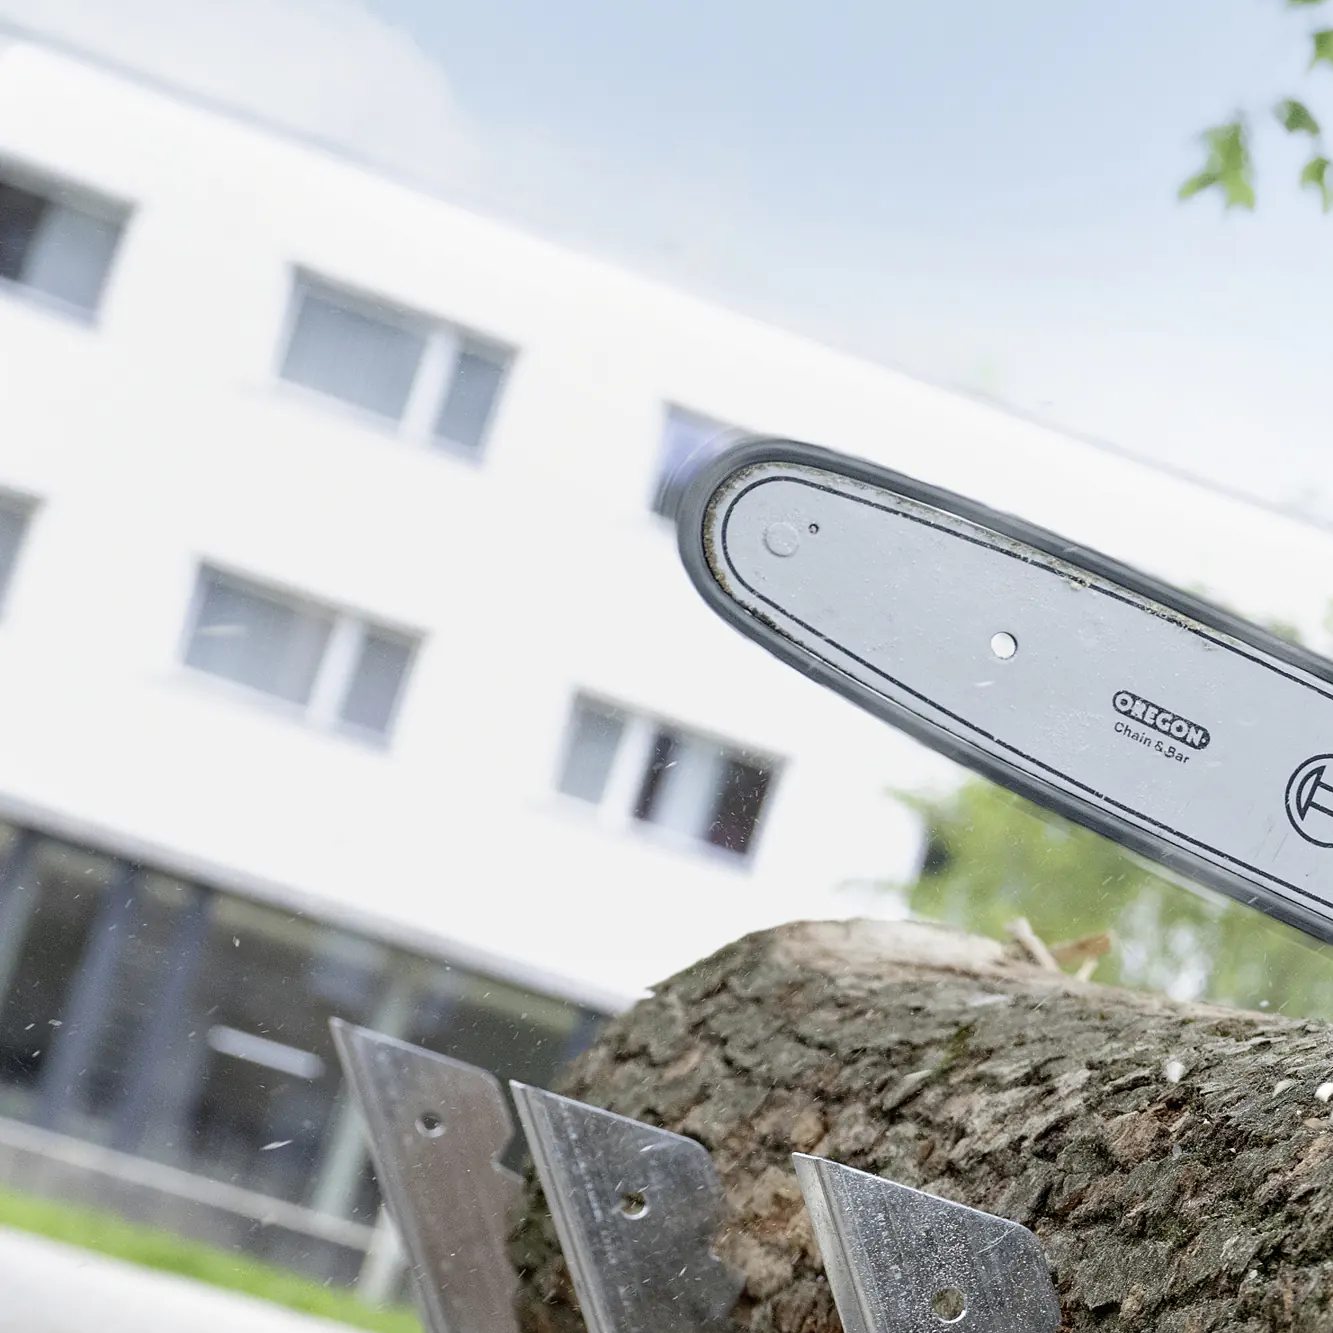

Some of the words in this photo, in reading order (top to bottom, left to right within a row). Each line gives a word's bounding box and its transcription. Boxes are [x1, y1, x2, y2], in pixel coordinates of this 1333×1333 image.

[1113, 691, 1206, 748] OREGON
[1114, 721, 1152, 747] Chain
[1154, 740, 1164, 753] &
[1164, 746, 1190, 764] Bar
